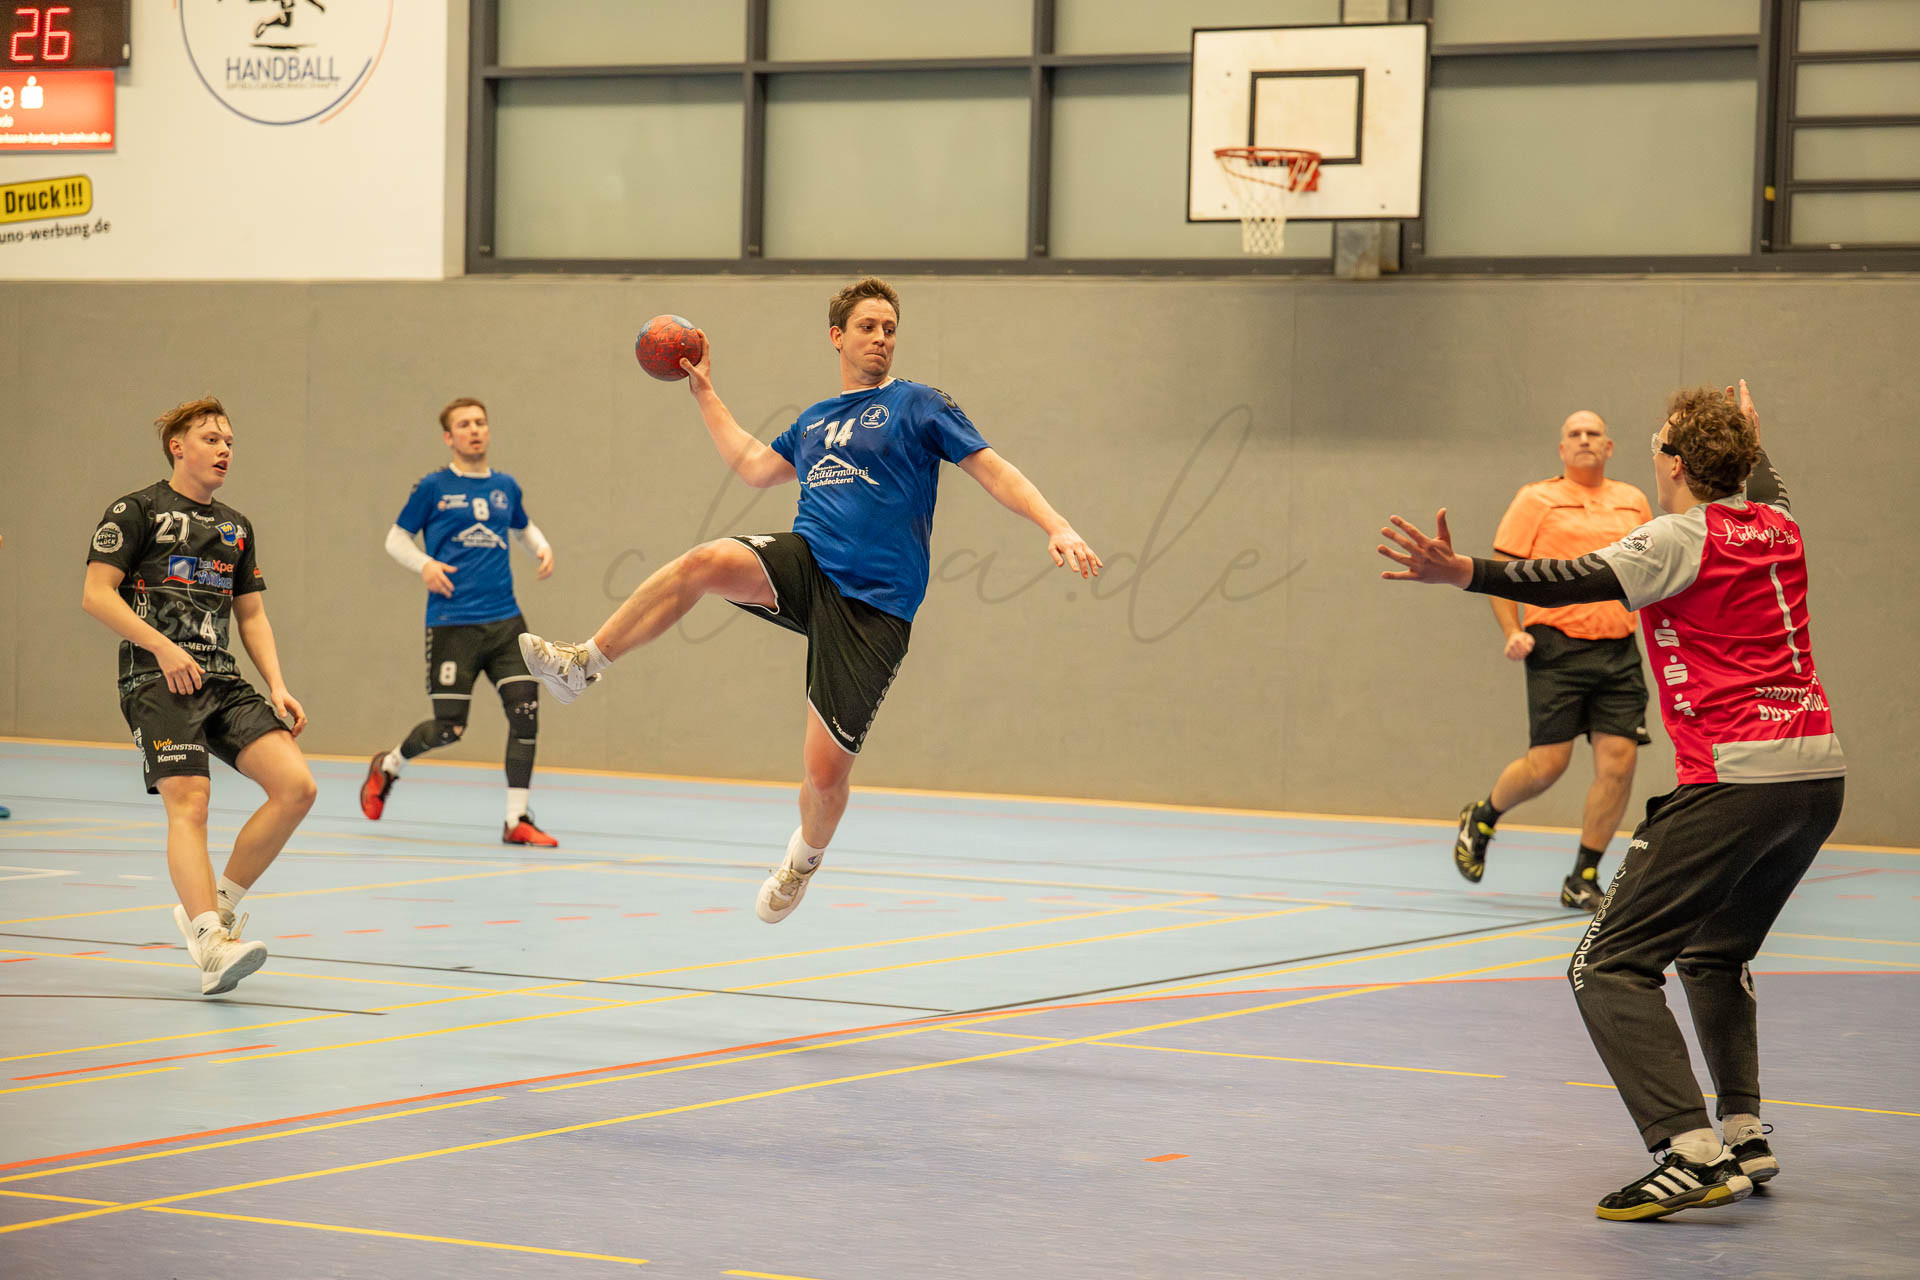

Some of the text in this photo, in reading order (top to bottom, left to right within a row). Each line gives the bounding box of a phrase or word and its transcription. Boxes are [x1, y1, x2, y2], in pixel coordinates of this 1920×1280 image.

[9, 7, 72, 62] 26
[225, 56, 341, 82] HANDBALL
[824, 417, 856, 450] 14
[472, 497, 490, 521] 8
[155, 511, 190, 543] 27
[1769, 562, 1802, 674] 1
[439, 661, 457, 686] 8
[157, 753, 187, 764] Kempa
